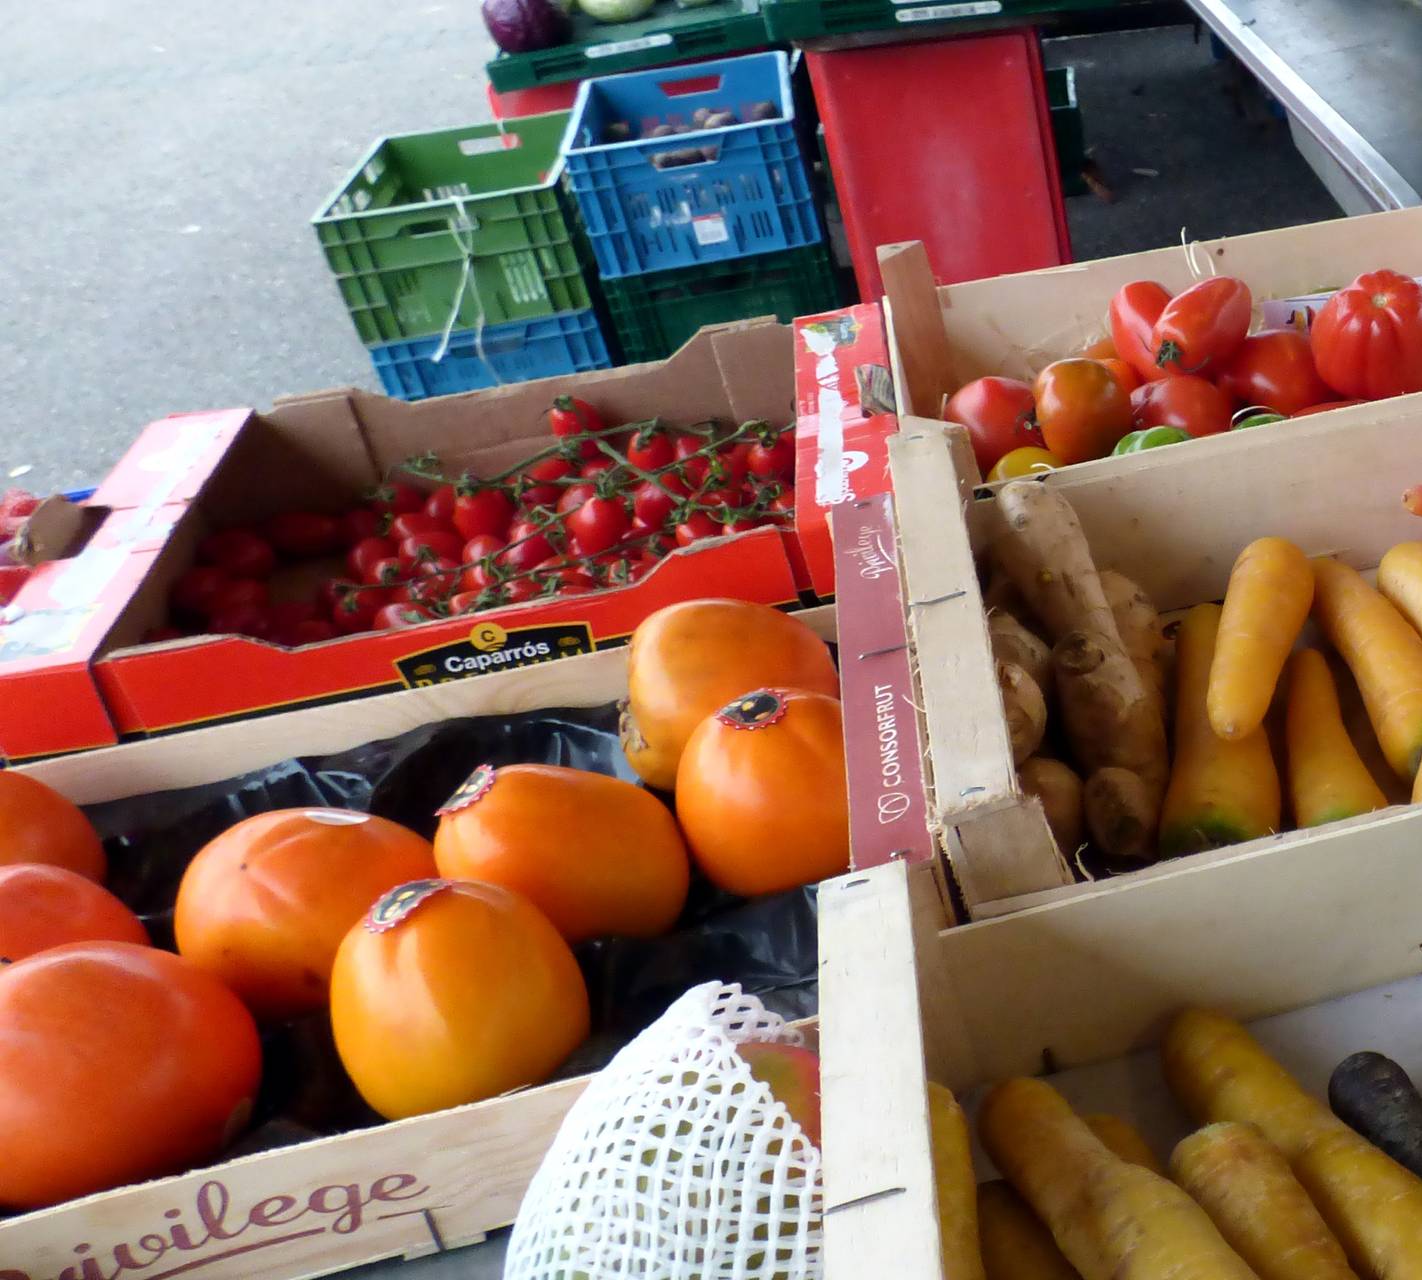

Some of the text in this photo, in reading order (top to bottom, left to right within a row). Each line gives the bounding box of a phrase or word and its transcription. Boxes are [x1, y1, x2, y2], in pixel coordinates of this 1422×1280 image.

[444, 640, 550, 673] Caparrós
[874, 684, 901, 788] CONSORFRUT
[0, 1173, 430, 1280] ivilege
